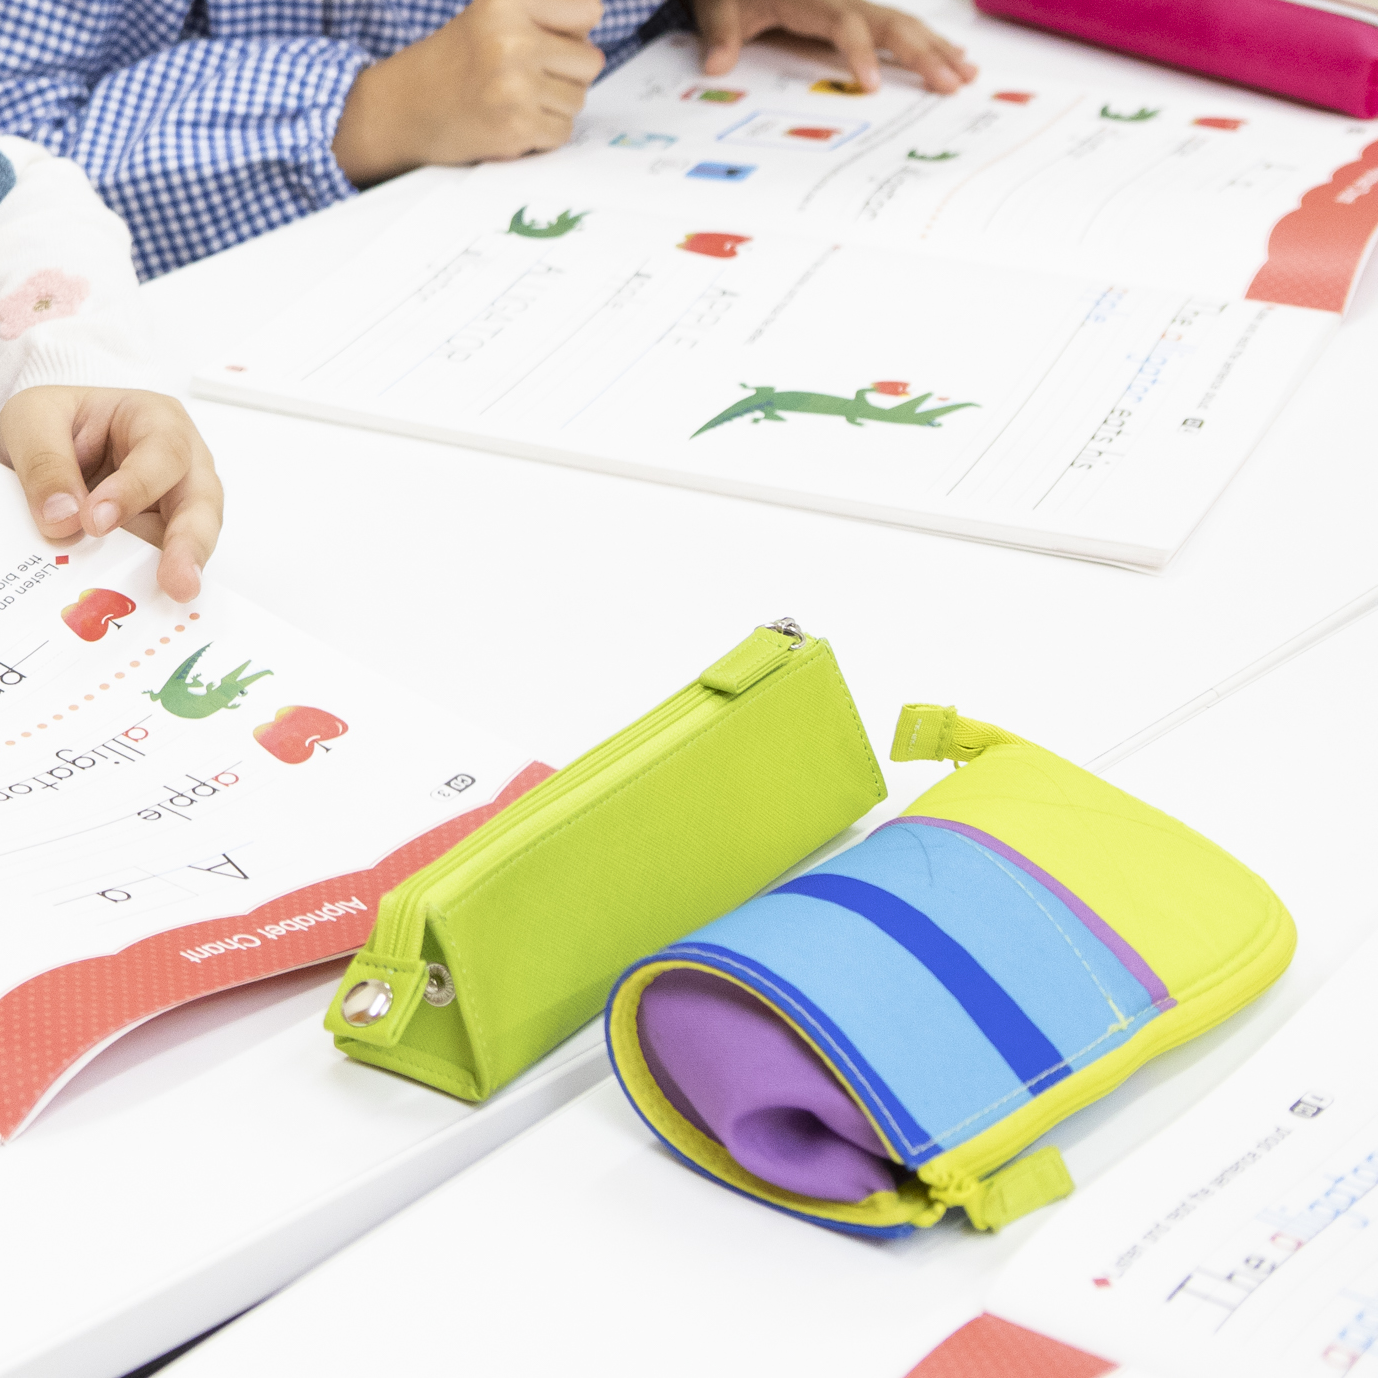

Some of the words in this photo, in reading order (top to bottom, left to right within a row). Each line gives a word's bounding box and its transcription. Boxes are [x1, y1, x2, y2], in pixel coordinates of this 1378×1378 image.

[14, 562, 59, 596] Listen
[17, 554, 43, 573] the
[136, 773, 240, 824] apple
[260, 894, 368, 939] Alphabet
[178, 931, 262, 965] Chant
[1165, 1255, 1277, 1312] The
